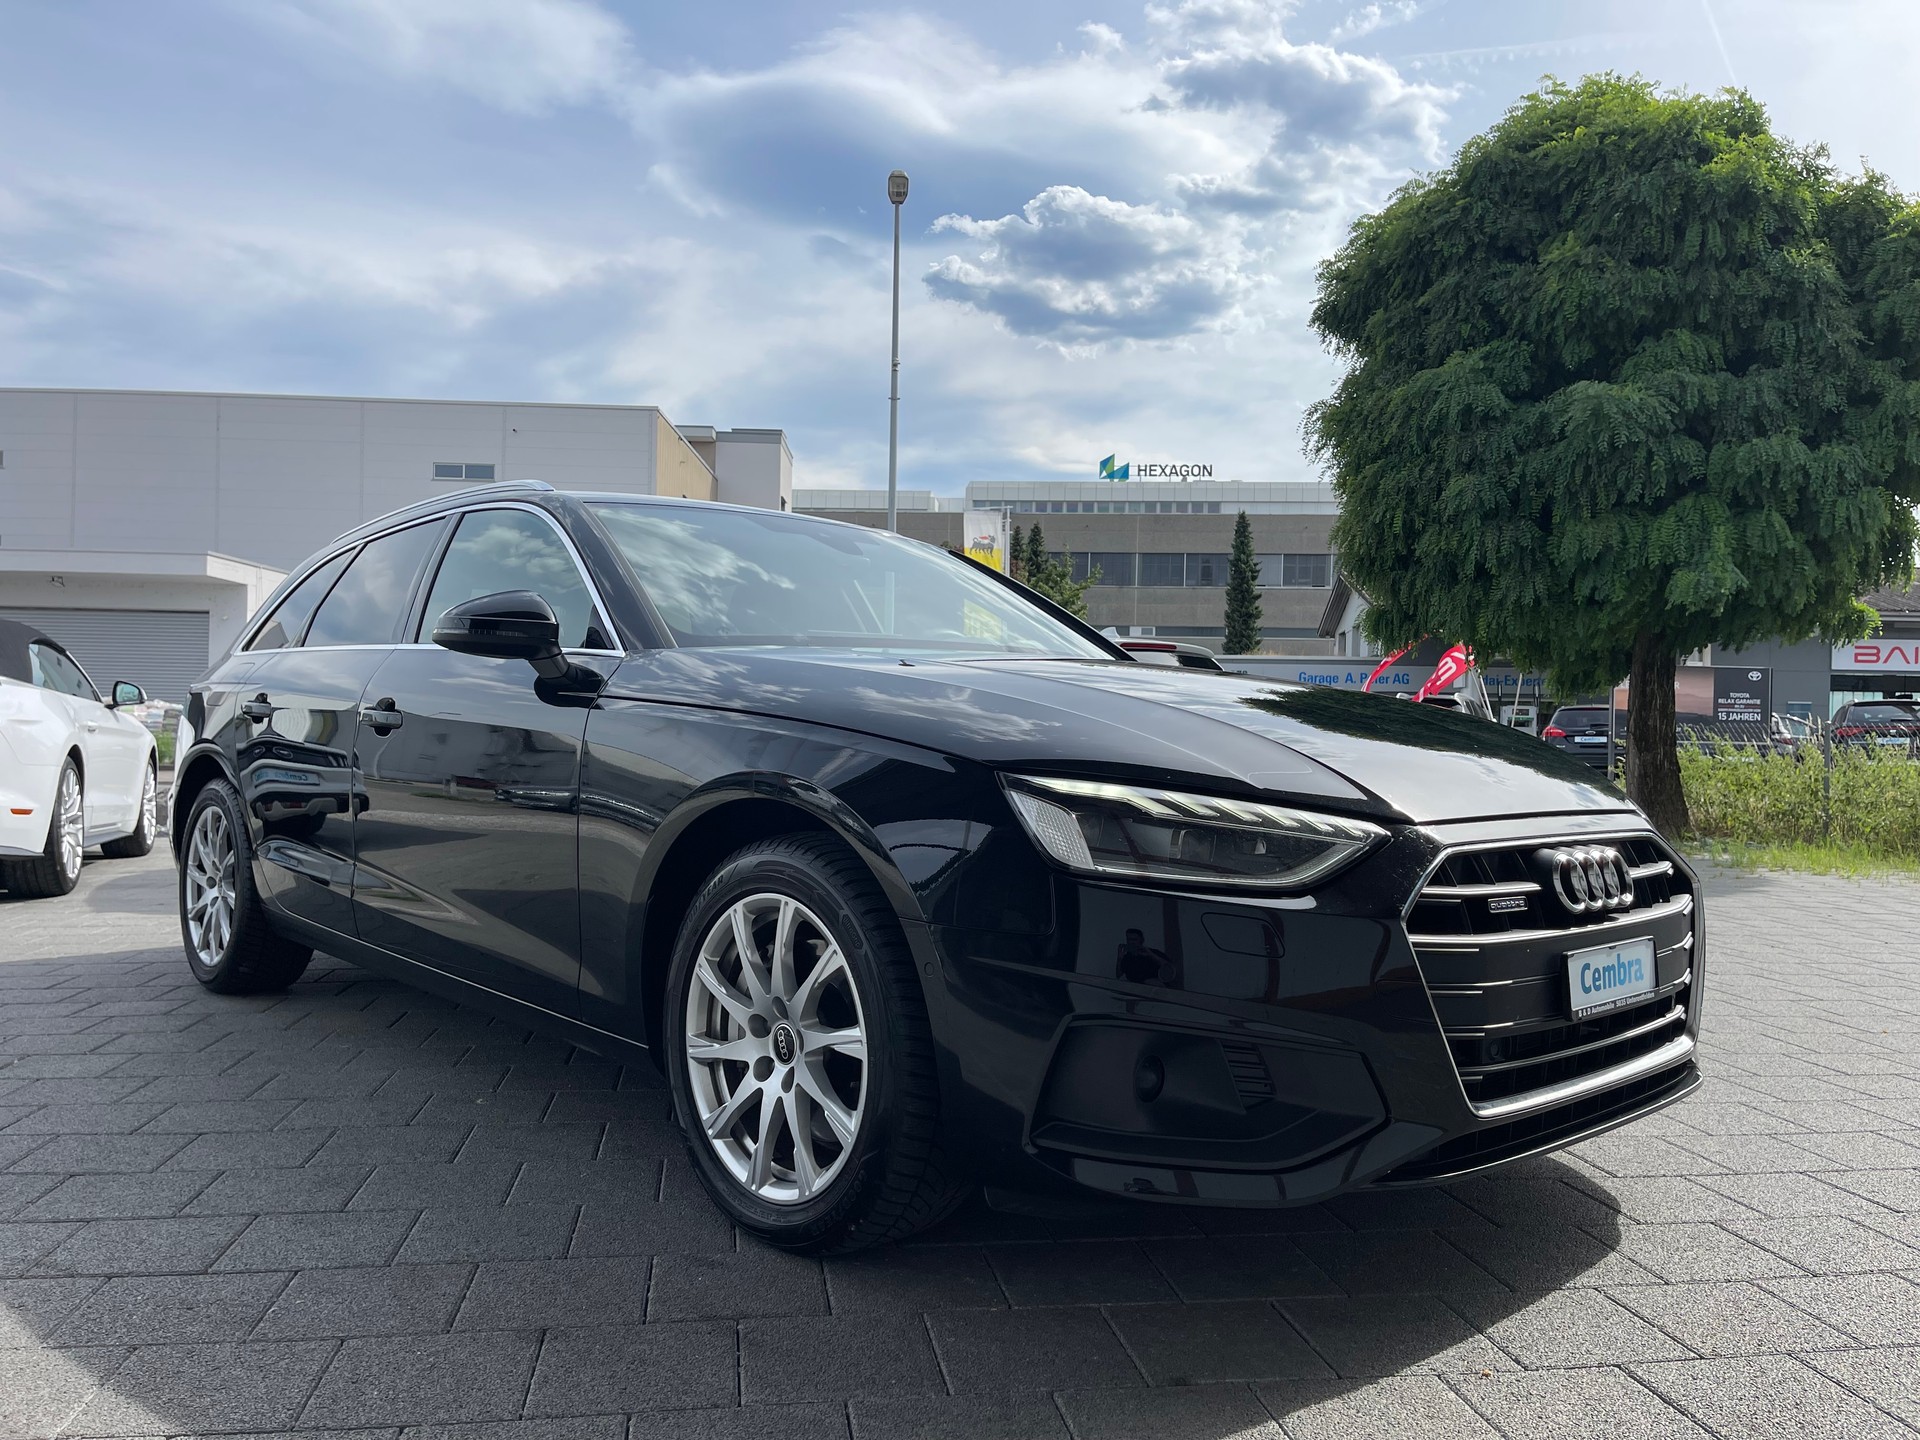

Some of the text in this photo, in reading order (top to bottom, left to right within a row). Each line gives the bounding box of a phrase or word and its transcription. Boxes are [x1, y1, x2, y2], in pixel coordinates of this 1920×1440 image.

[1137, 464, 1213, 477] HEXAGON
[1298, 671, 1339, 685] Garage
[1345, 672, 1356, 684] A.
[1392, 673, 1410, 685] AG
[1718, 712, 1761, 721] 15 JAHREN
[1580, 952, 1644, 994] Cembra
